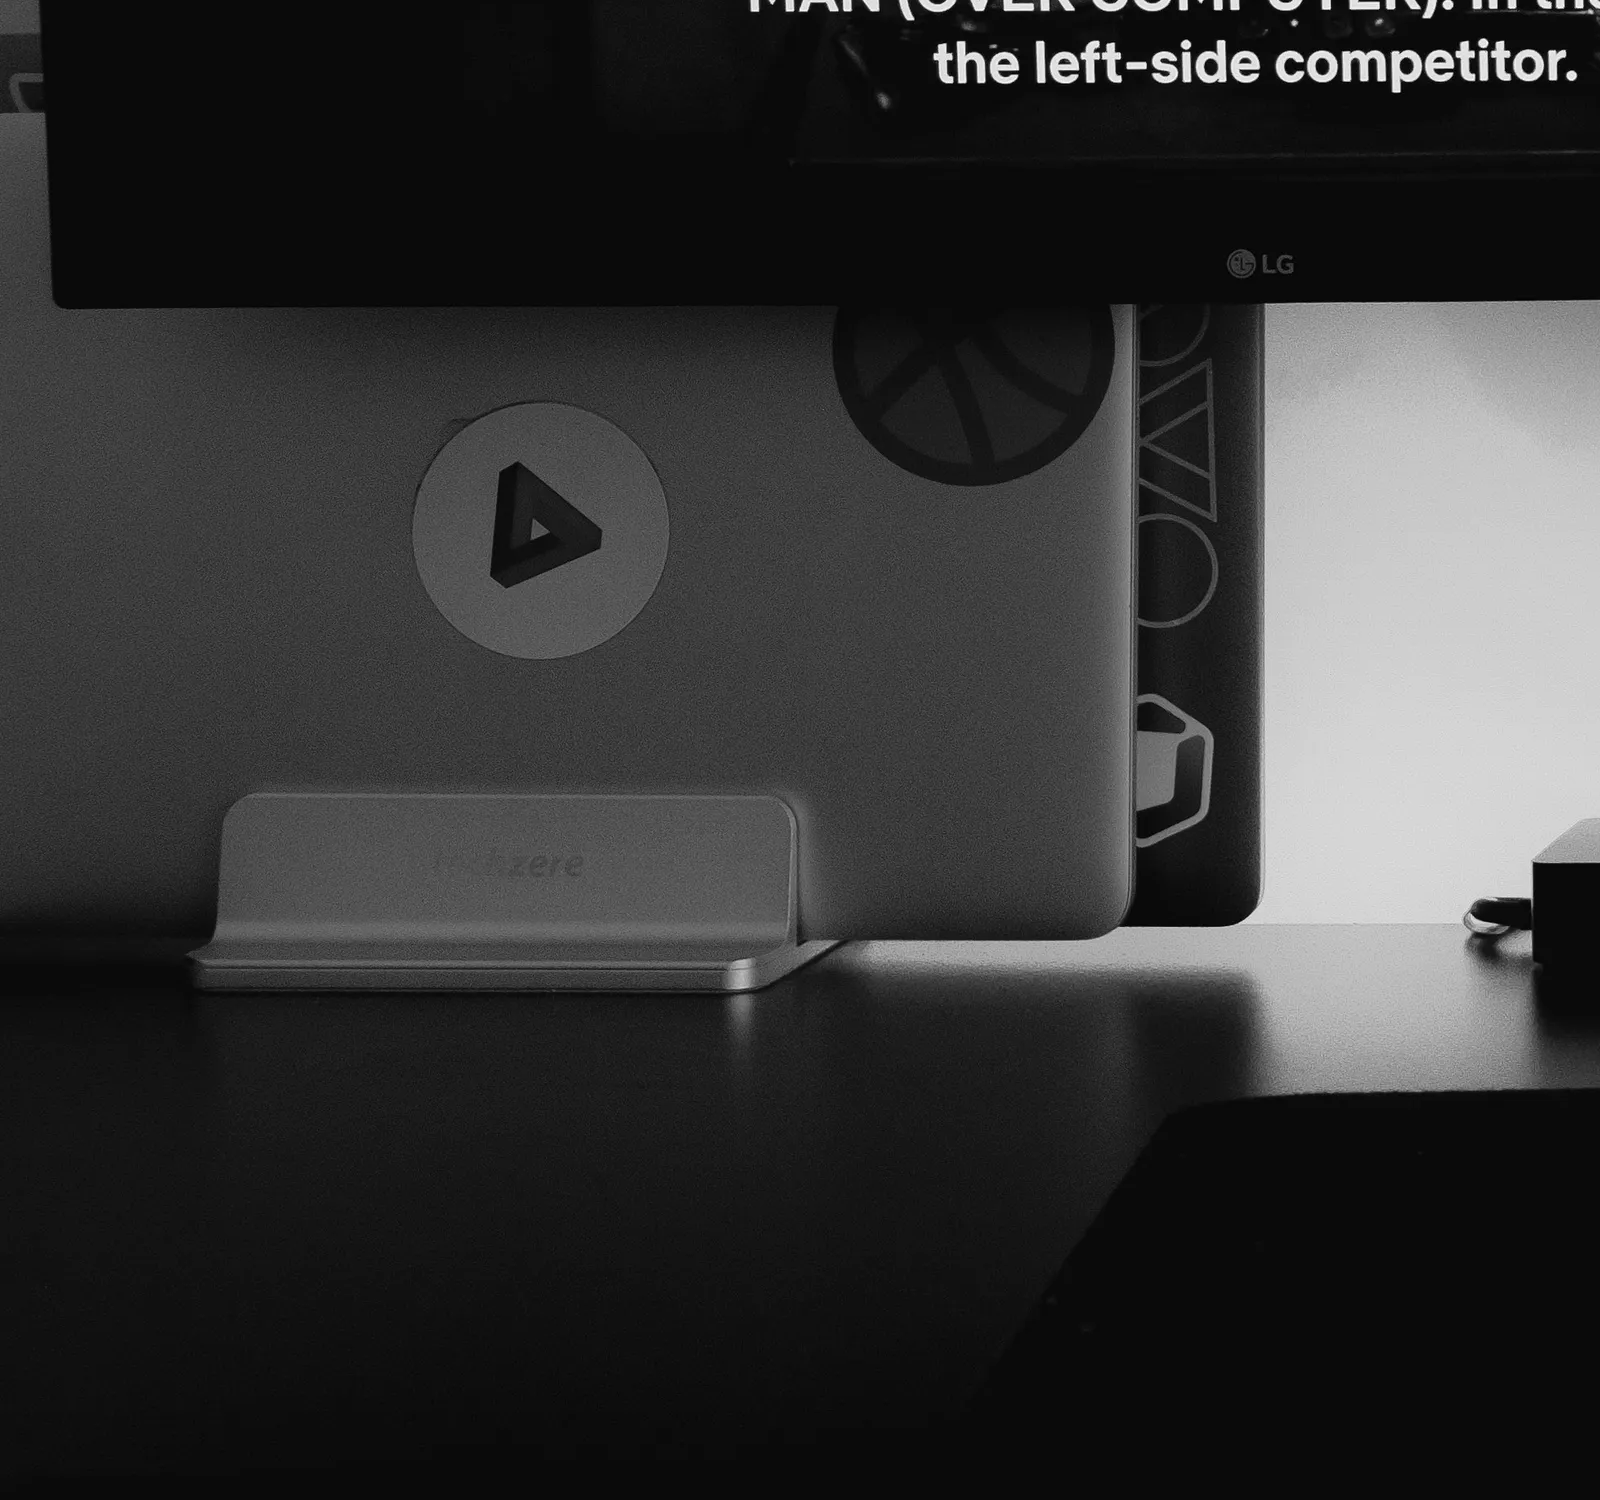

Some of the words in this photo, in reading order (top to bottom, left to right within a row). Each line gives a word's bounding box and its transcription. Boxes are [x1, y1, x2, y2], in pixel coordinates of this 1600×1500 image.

[934, 41, 1019, 83] the
[1036, 40, 1260, 83] left-side
[1276, 39, 1577, 92] competitor.
[1262, 254, 1294, 274] LG
